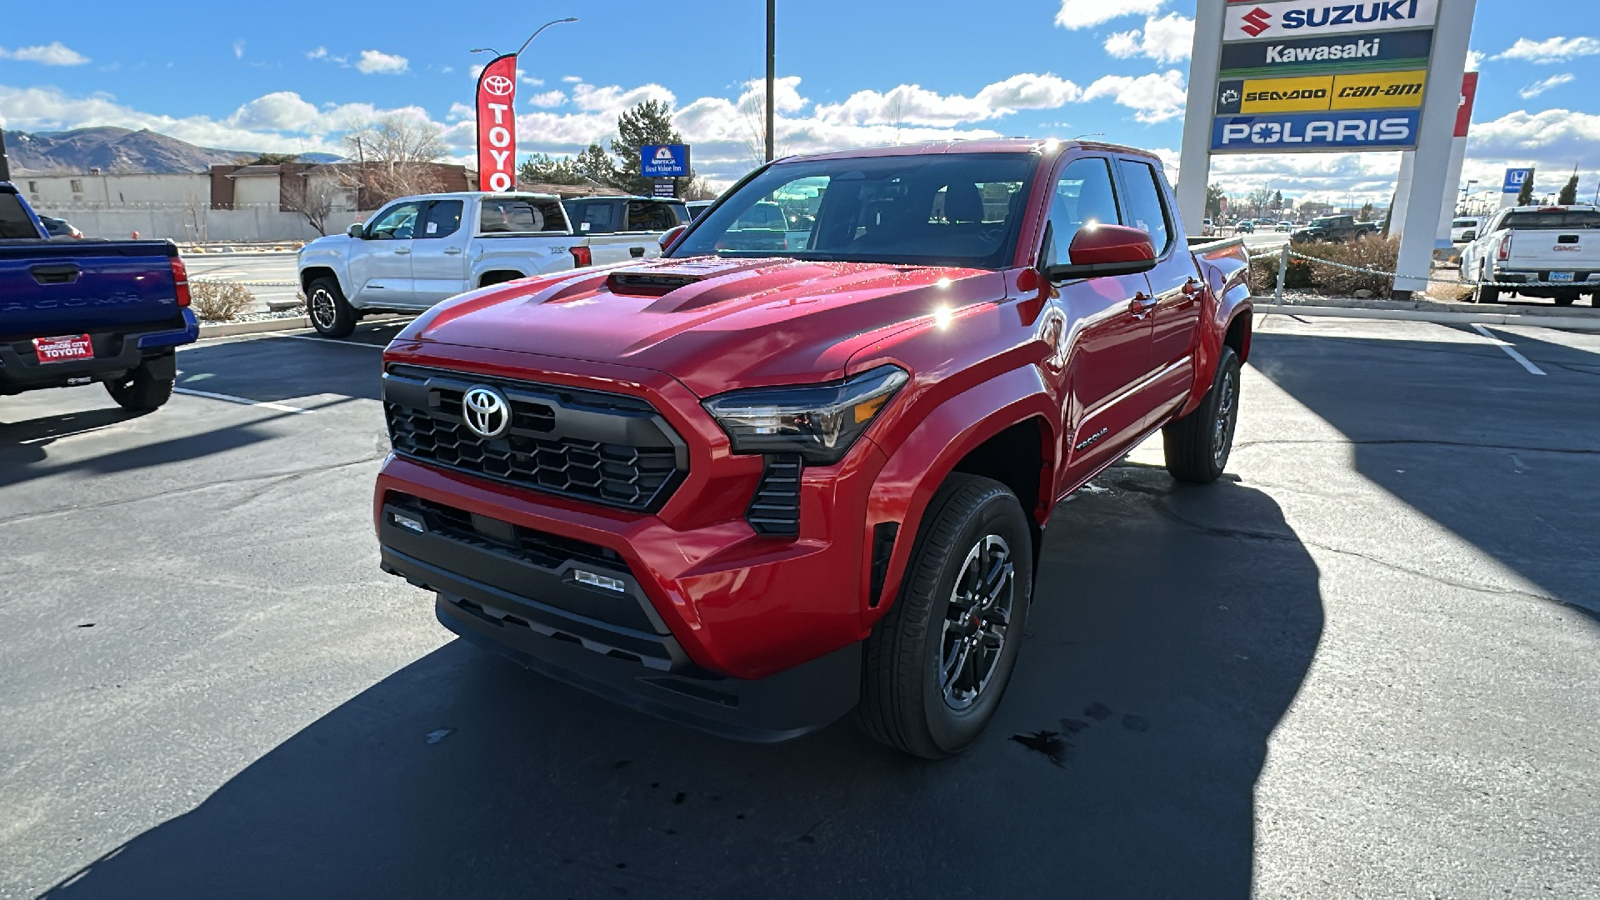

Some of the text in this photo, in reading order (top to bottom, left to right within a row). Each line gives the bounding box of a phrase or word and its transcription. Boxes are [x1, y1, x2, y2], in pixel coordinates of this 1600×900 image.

[1282, 0, 1417, 29] SUZUKI
[1266, 38, 1380, 63] Kawasaki
[1222, 117, 1409, 144] POLARIS
[657, 164, 672, 172] Value
[673, 164, 682, 172] Inn
[38, 341, 89, 351] CARSON CITY
[45, 347, 86, 357] TOYOTA
